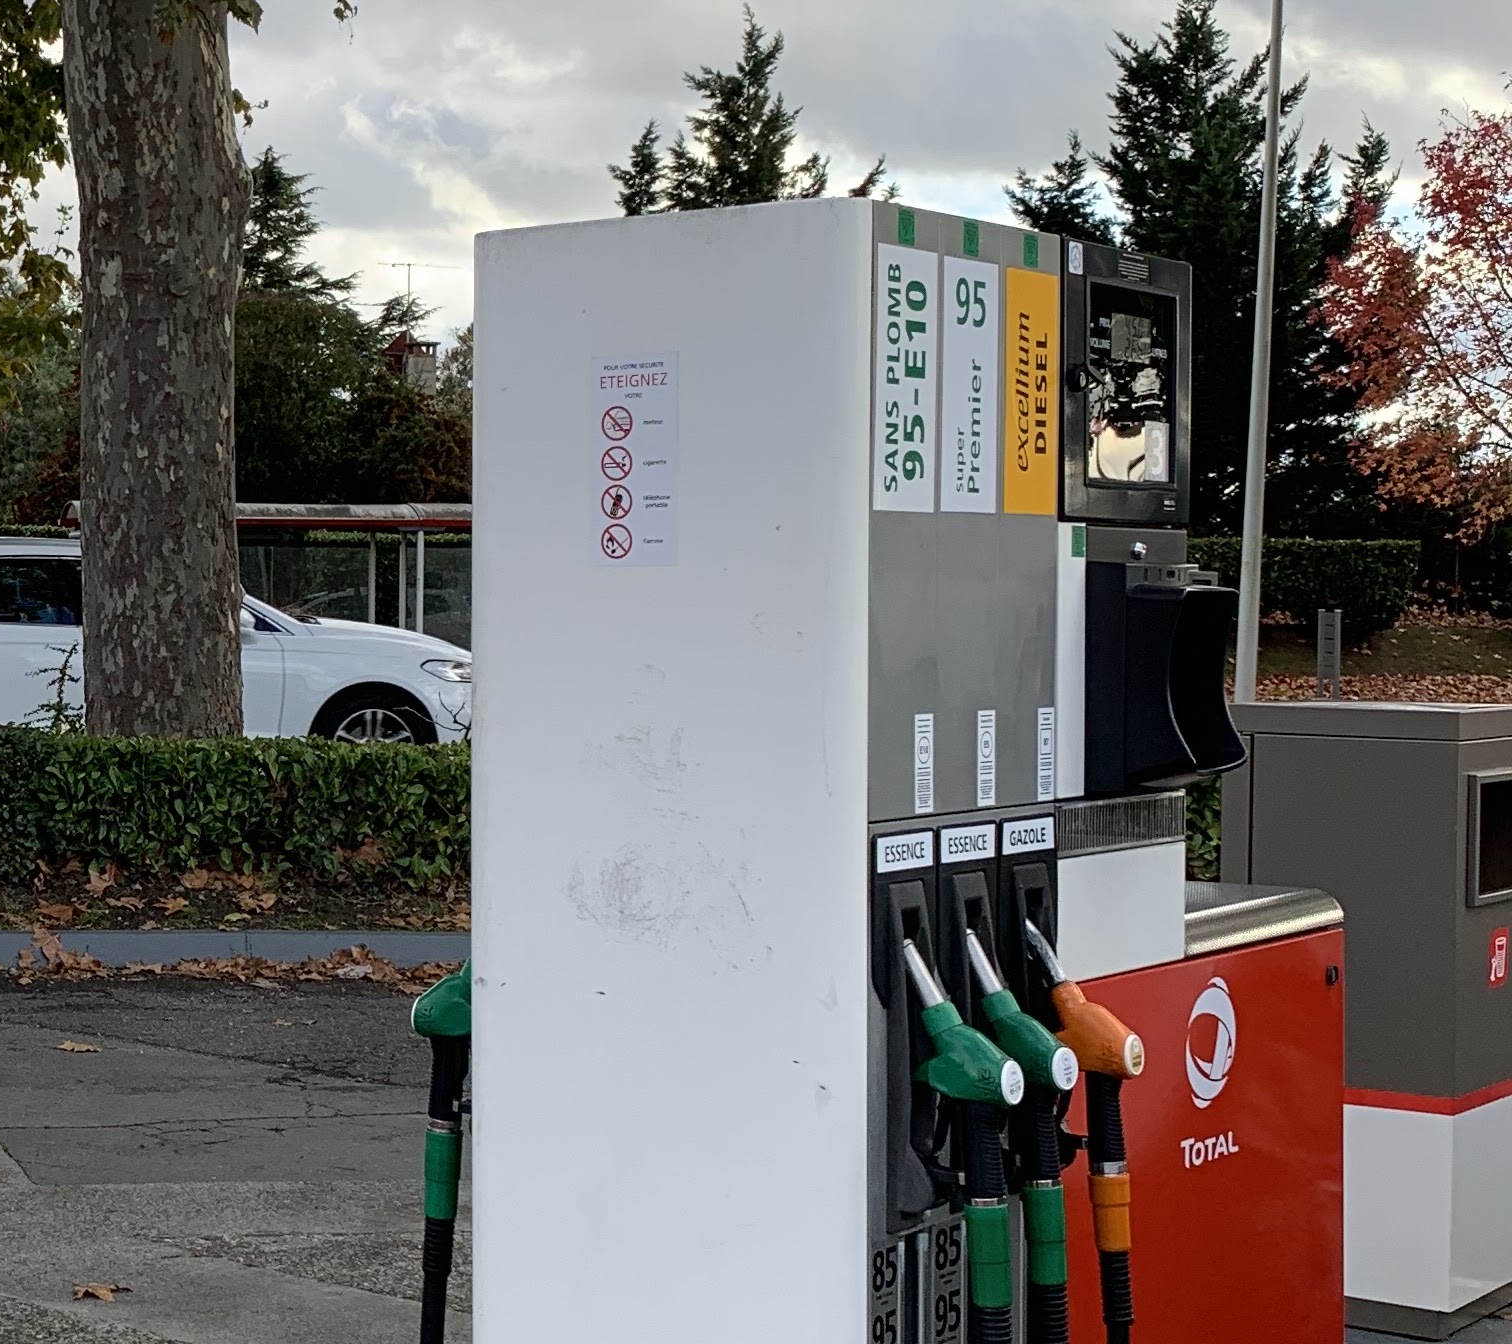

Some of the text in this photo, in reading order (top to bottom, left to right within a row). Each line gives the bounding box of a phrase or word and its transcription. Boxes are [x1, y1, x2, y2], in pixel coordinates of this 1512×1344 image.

[956, 277, 986, 328] 95
[600, 372, 668, 389] ETEIGNEZ
[884, 263, 902, 493] SANS PLOMB
[902, 280, 927, 481] 95-E10
[1015, 312, 1030, 472] excellium
[1034, 332, 1048, 454] DIESEL
[967, 359, 982, 493] Premier
[956, 427, 965, 492] super
[1151, 429, 1163, 475] 3
[884, 841, 925, 863] ESSENCE
[948, 833, 988, 854] ESSENCE
[1009, 827, 1047, 846] GAZOLE
[1180, 1130, 1239, 1168] TOTAL
[872, 1245, 897, 1293] 85
[935, 1223, 961, 1271] 85
[935, 1288, 961, 1338] 95
